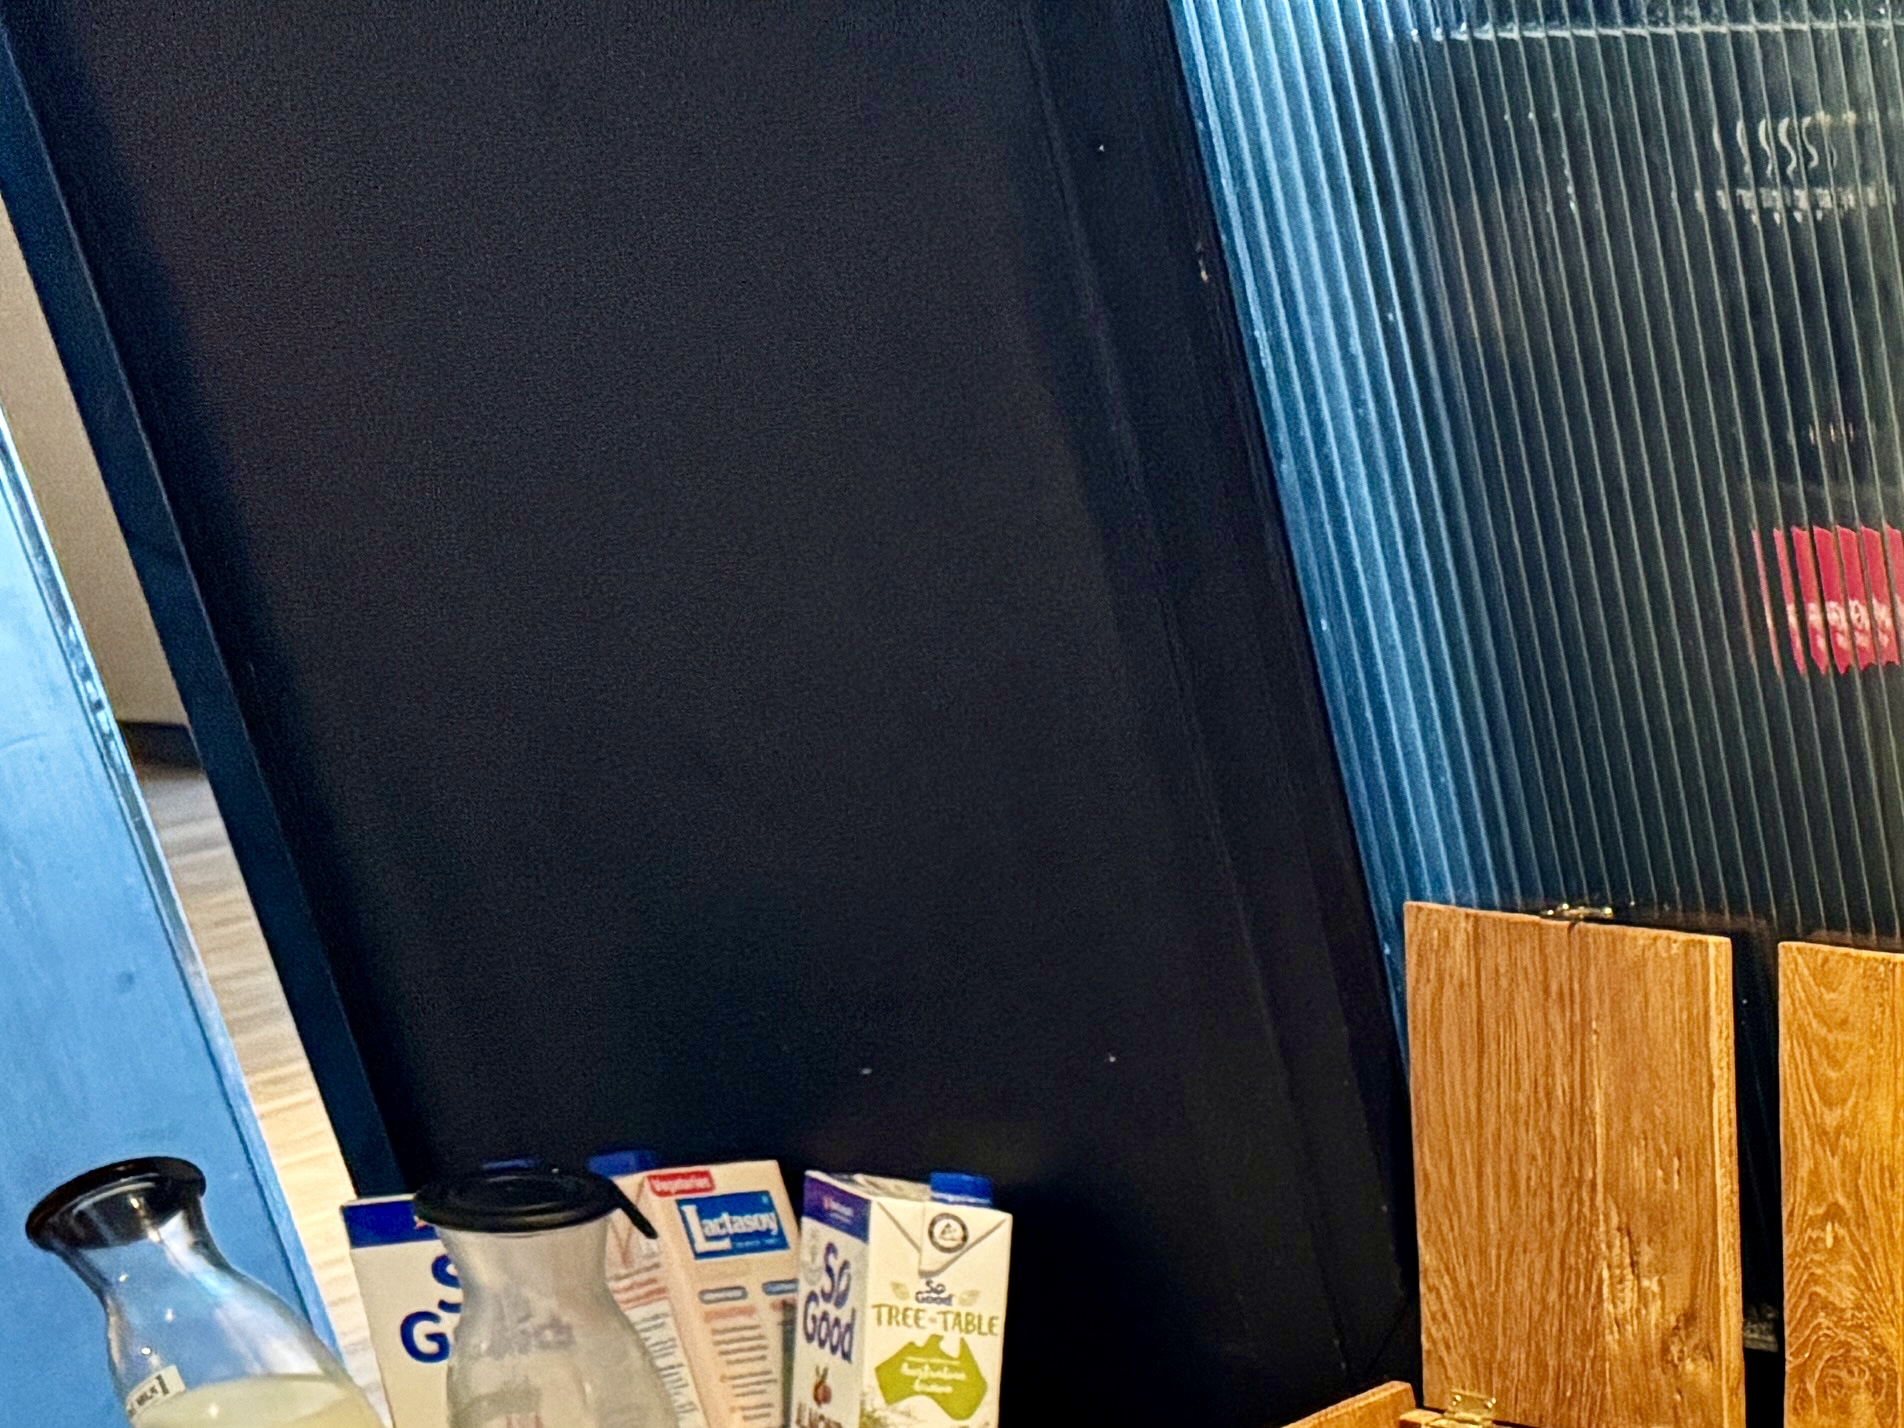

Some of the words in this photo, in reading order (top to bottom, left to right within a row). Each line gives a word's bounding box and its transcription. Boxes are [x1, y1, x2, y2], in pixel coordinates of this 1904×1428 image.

[680, 1204, 779, 1254] Lactasoy
[820, 1242, 851, 1310] So
[803, 1290, 856, 1364] Good
[871, 1303, 927, 1329] TREE
[936, 1310, 999, 1336] TABLE
